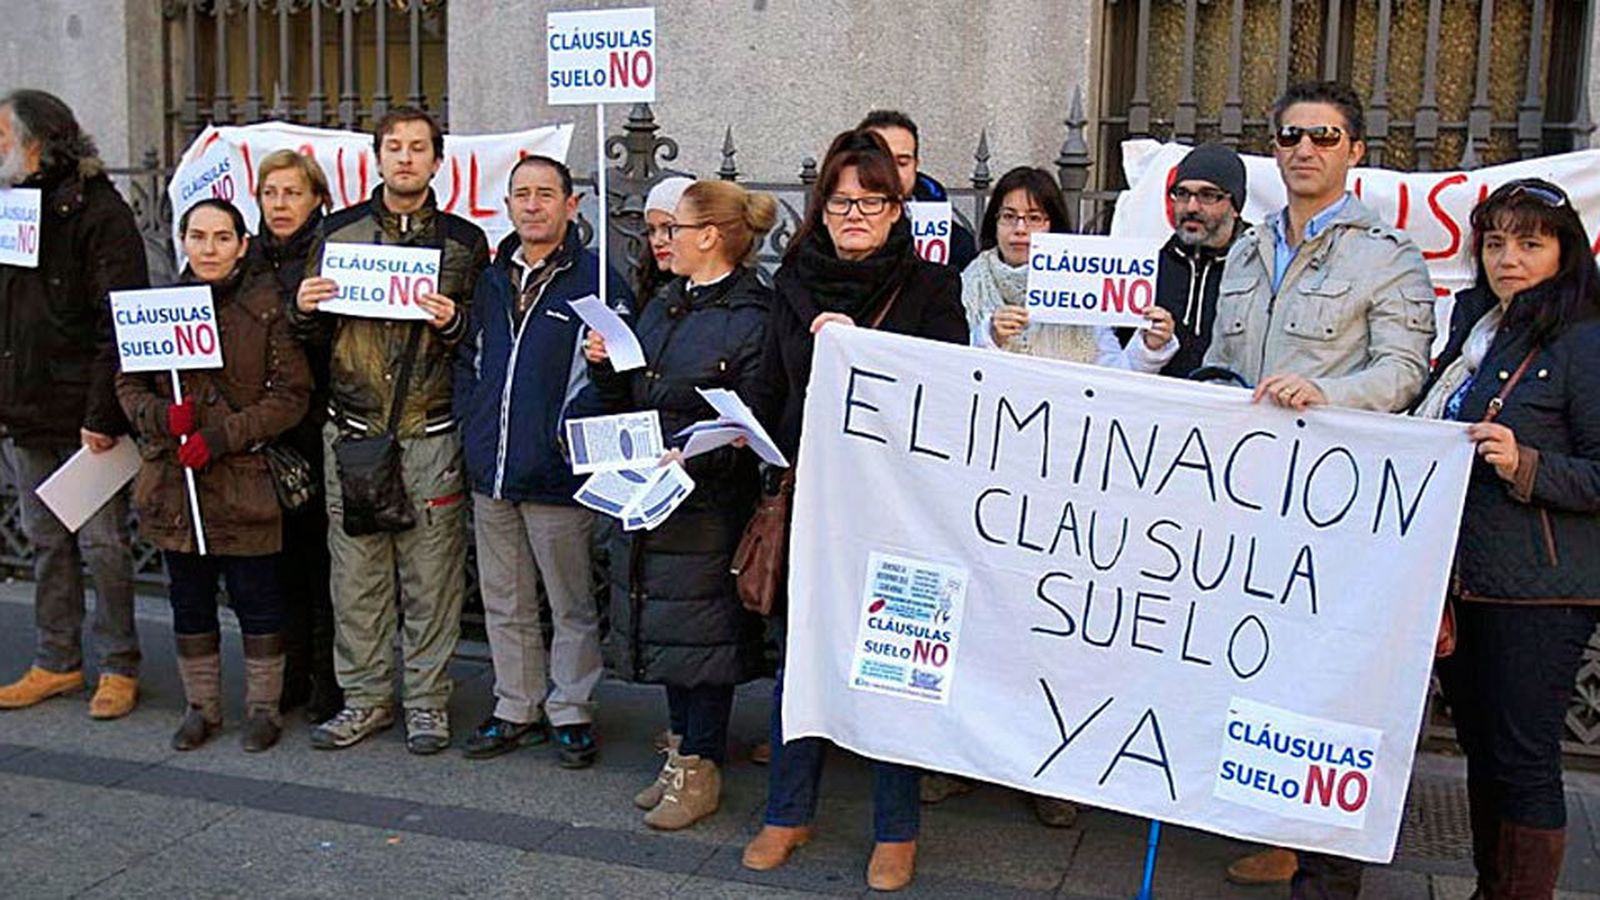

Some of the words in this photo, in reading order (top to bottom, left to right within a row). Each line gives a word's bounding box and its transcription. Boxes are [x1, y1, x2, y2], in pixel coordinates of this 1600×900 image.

[549, 26, 652, 51] CLÁUSULAS
[550, 69, 606, 88] SUELO
[609, 50, 653, 88] NO
[17, 223, 37, 254] NO
[326, 254, 437, 275] CLÁUSULAS
[1032, 250, 1155, 276] CLÁUSULAS
[335, 286, 385, 302] UELO
[388, 275, 434, 307] NO
[1028, 289, 1097, 309] SUELO
[1101, 278, 1152, 315] NO
[116, 304, 212, 325] CLÁUSULAS
[121, 339, 174, 357] SUELO
[174, 323, 215, 356] NO
[974, 488, 1320, 613] CLAUSULA
[867, 616, 951, 643] CLÁUSULAS
[1030, 572, 1269, 680] SUELO
[864, 640, 911, 660] SUELO
[912, 639, 949, 668] NO
[1034, 677, 1177, 800] YA
[1228, 721, 1374, 770] CLÁUSULAS
[1220, 760, 1300, 799] SUELO
[1303, 764, 1368, 812] NO
